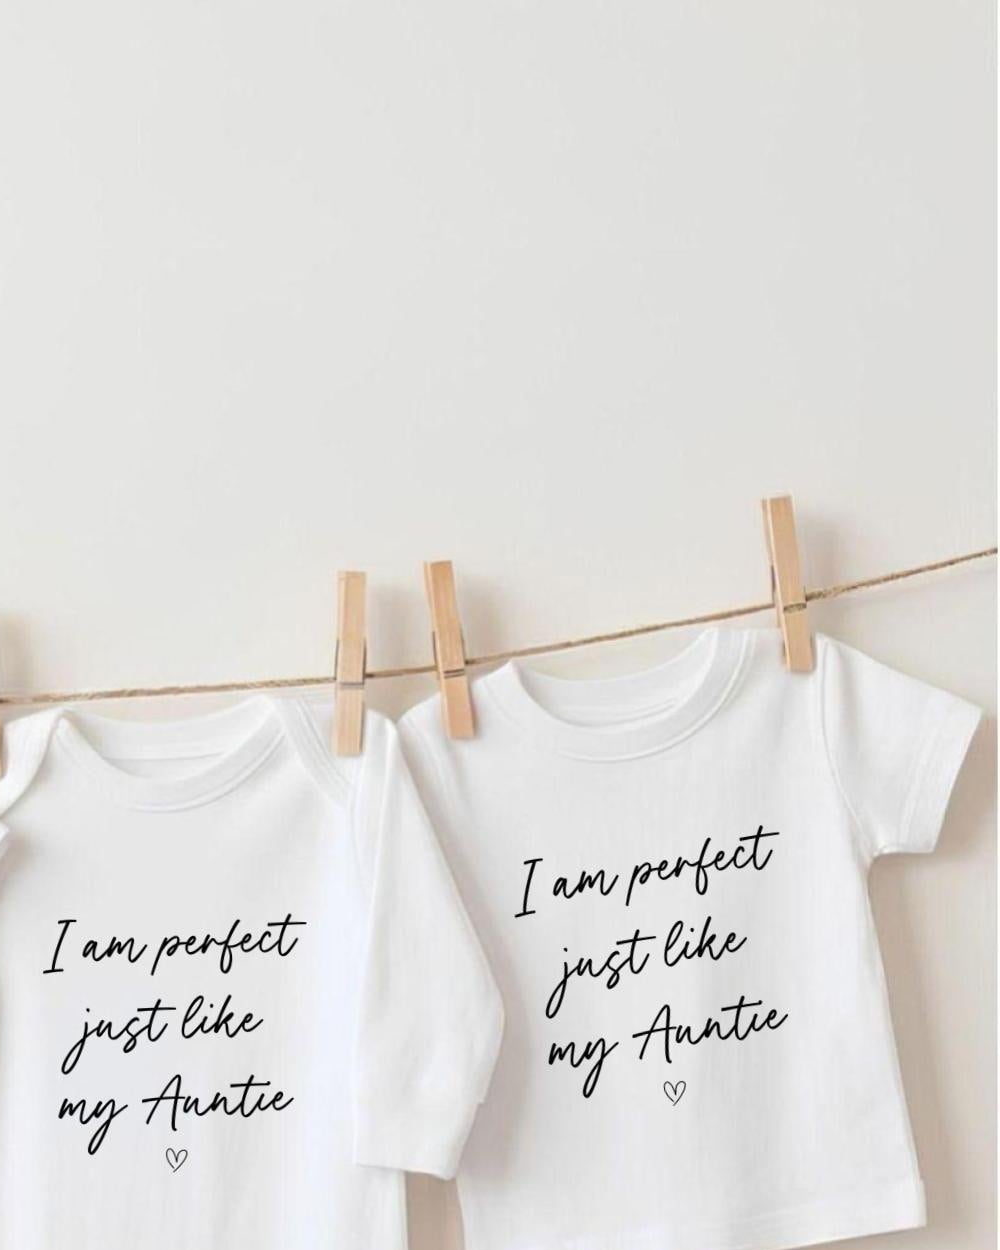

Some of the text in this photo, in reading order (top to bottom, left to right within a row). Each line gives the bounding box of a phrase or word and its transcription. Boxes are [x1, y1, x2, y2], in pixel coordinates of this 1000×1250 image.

[514, 824, 780, 919] I am perfect
[42, 913, 307, 977] I am perfect
[545, 915, 748, 1020] just like
[61, 994, 264, 1075] just like
[548, 995, 789, 1099] my Auntie
[57, 1074, 295, 1156] my Auntie
